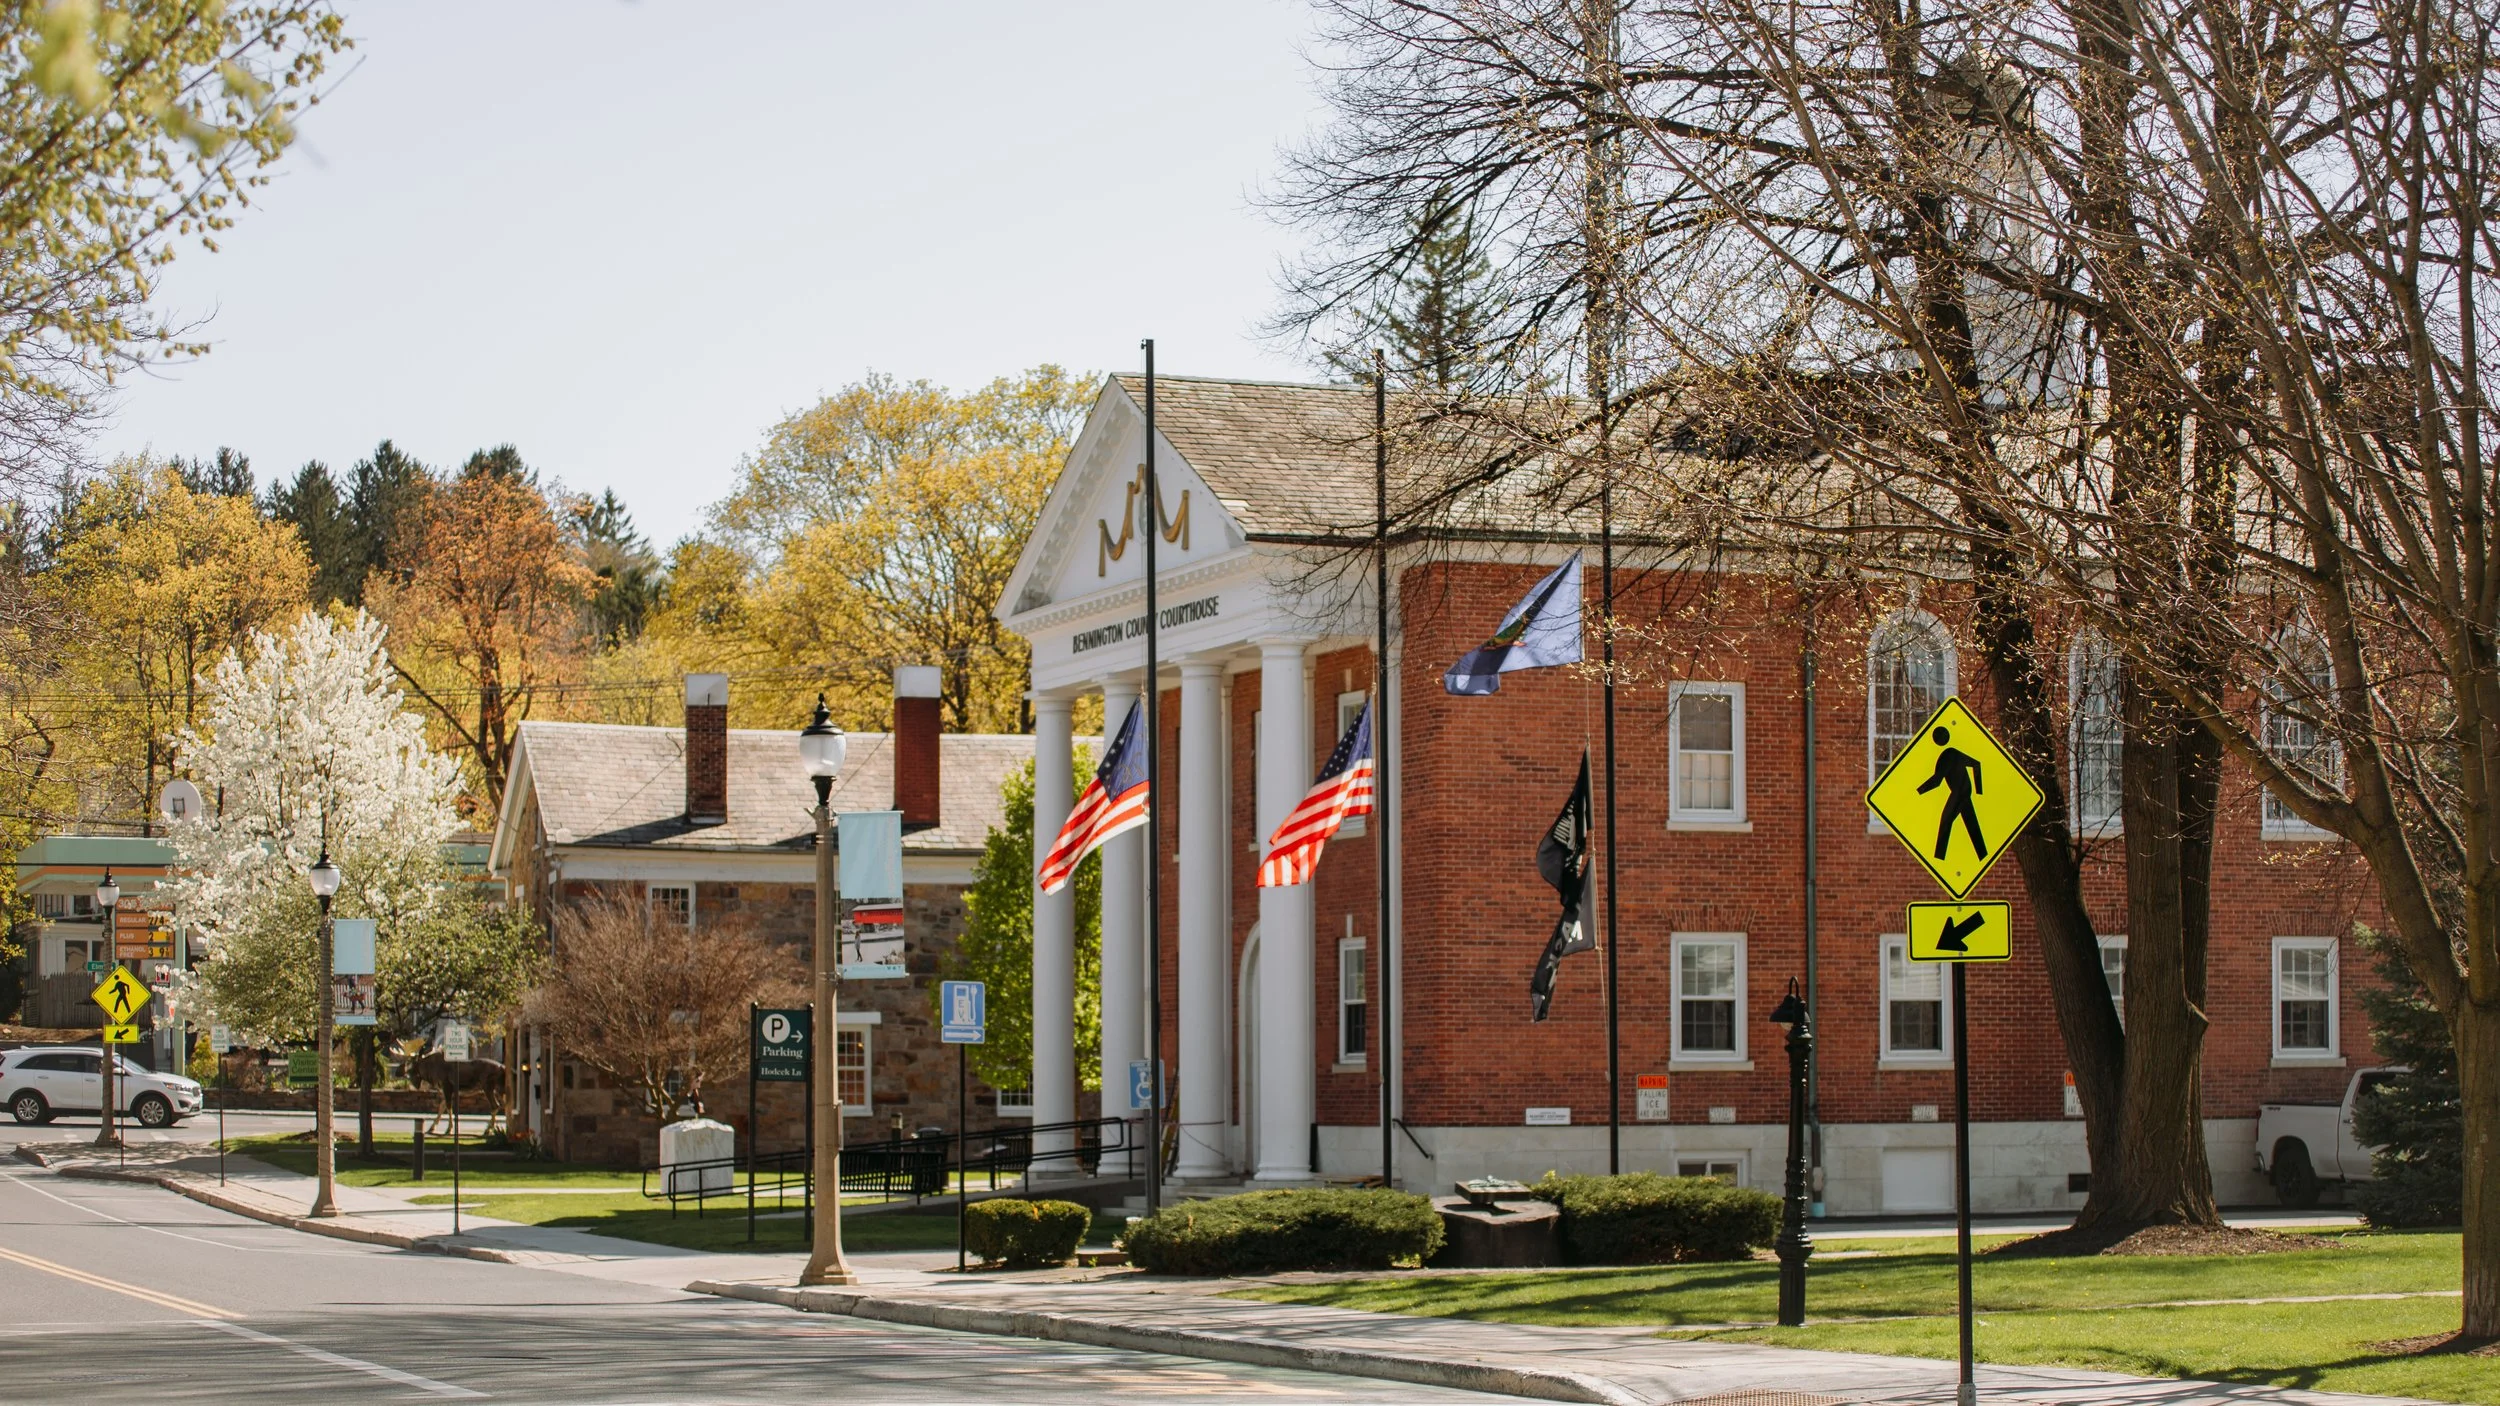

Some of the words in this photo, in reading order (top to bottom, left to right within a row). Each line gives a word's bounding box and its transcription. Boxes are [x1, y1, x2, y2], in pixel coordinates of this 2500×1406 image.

[1073, 622, 1123, 654] BENNINGTON
[1126, 612, 1158, 639] COUN
[1160, 596, 1219, 629] COURTHOUSE
[771, 1018, 783, 1038] P
[762, 1046, 803, 1059] Parking
[292, 1058, 317, 1066] Visitor
[292, 1066, 318, 1074] Center
[792, 1068, 802, 1076] Ln
[1640, 1077, 1666, 1086] WARNING
[1646, 1100, 1660, 1108] ICE
